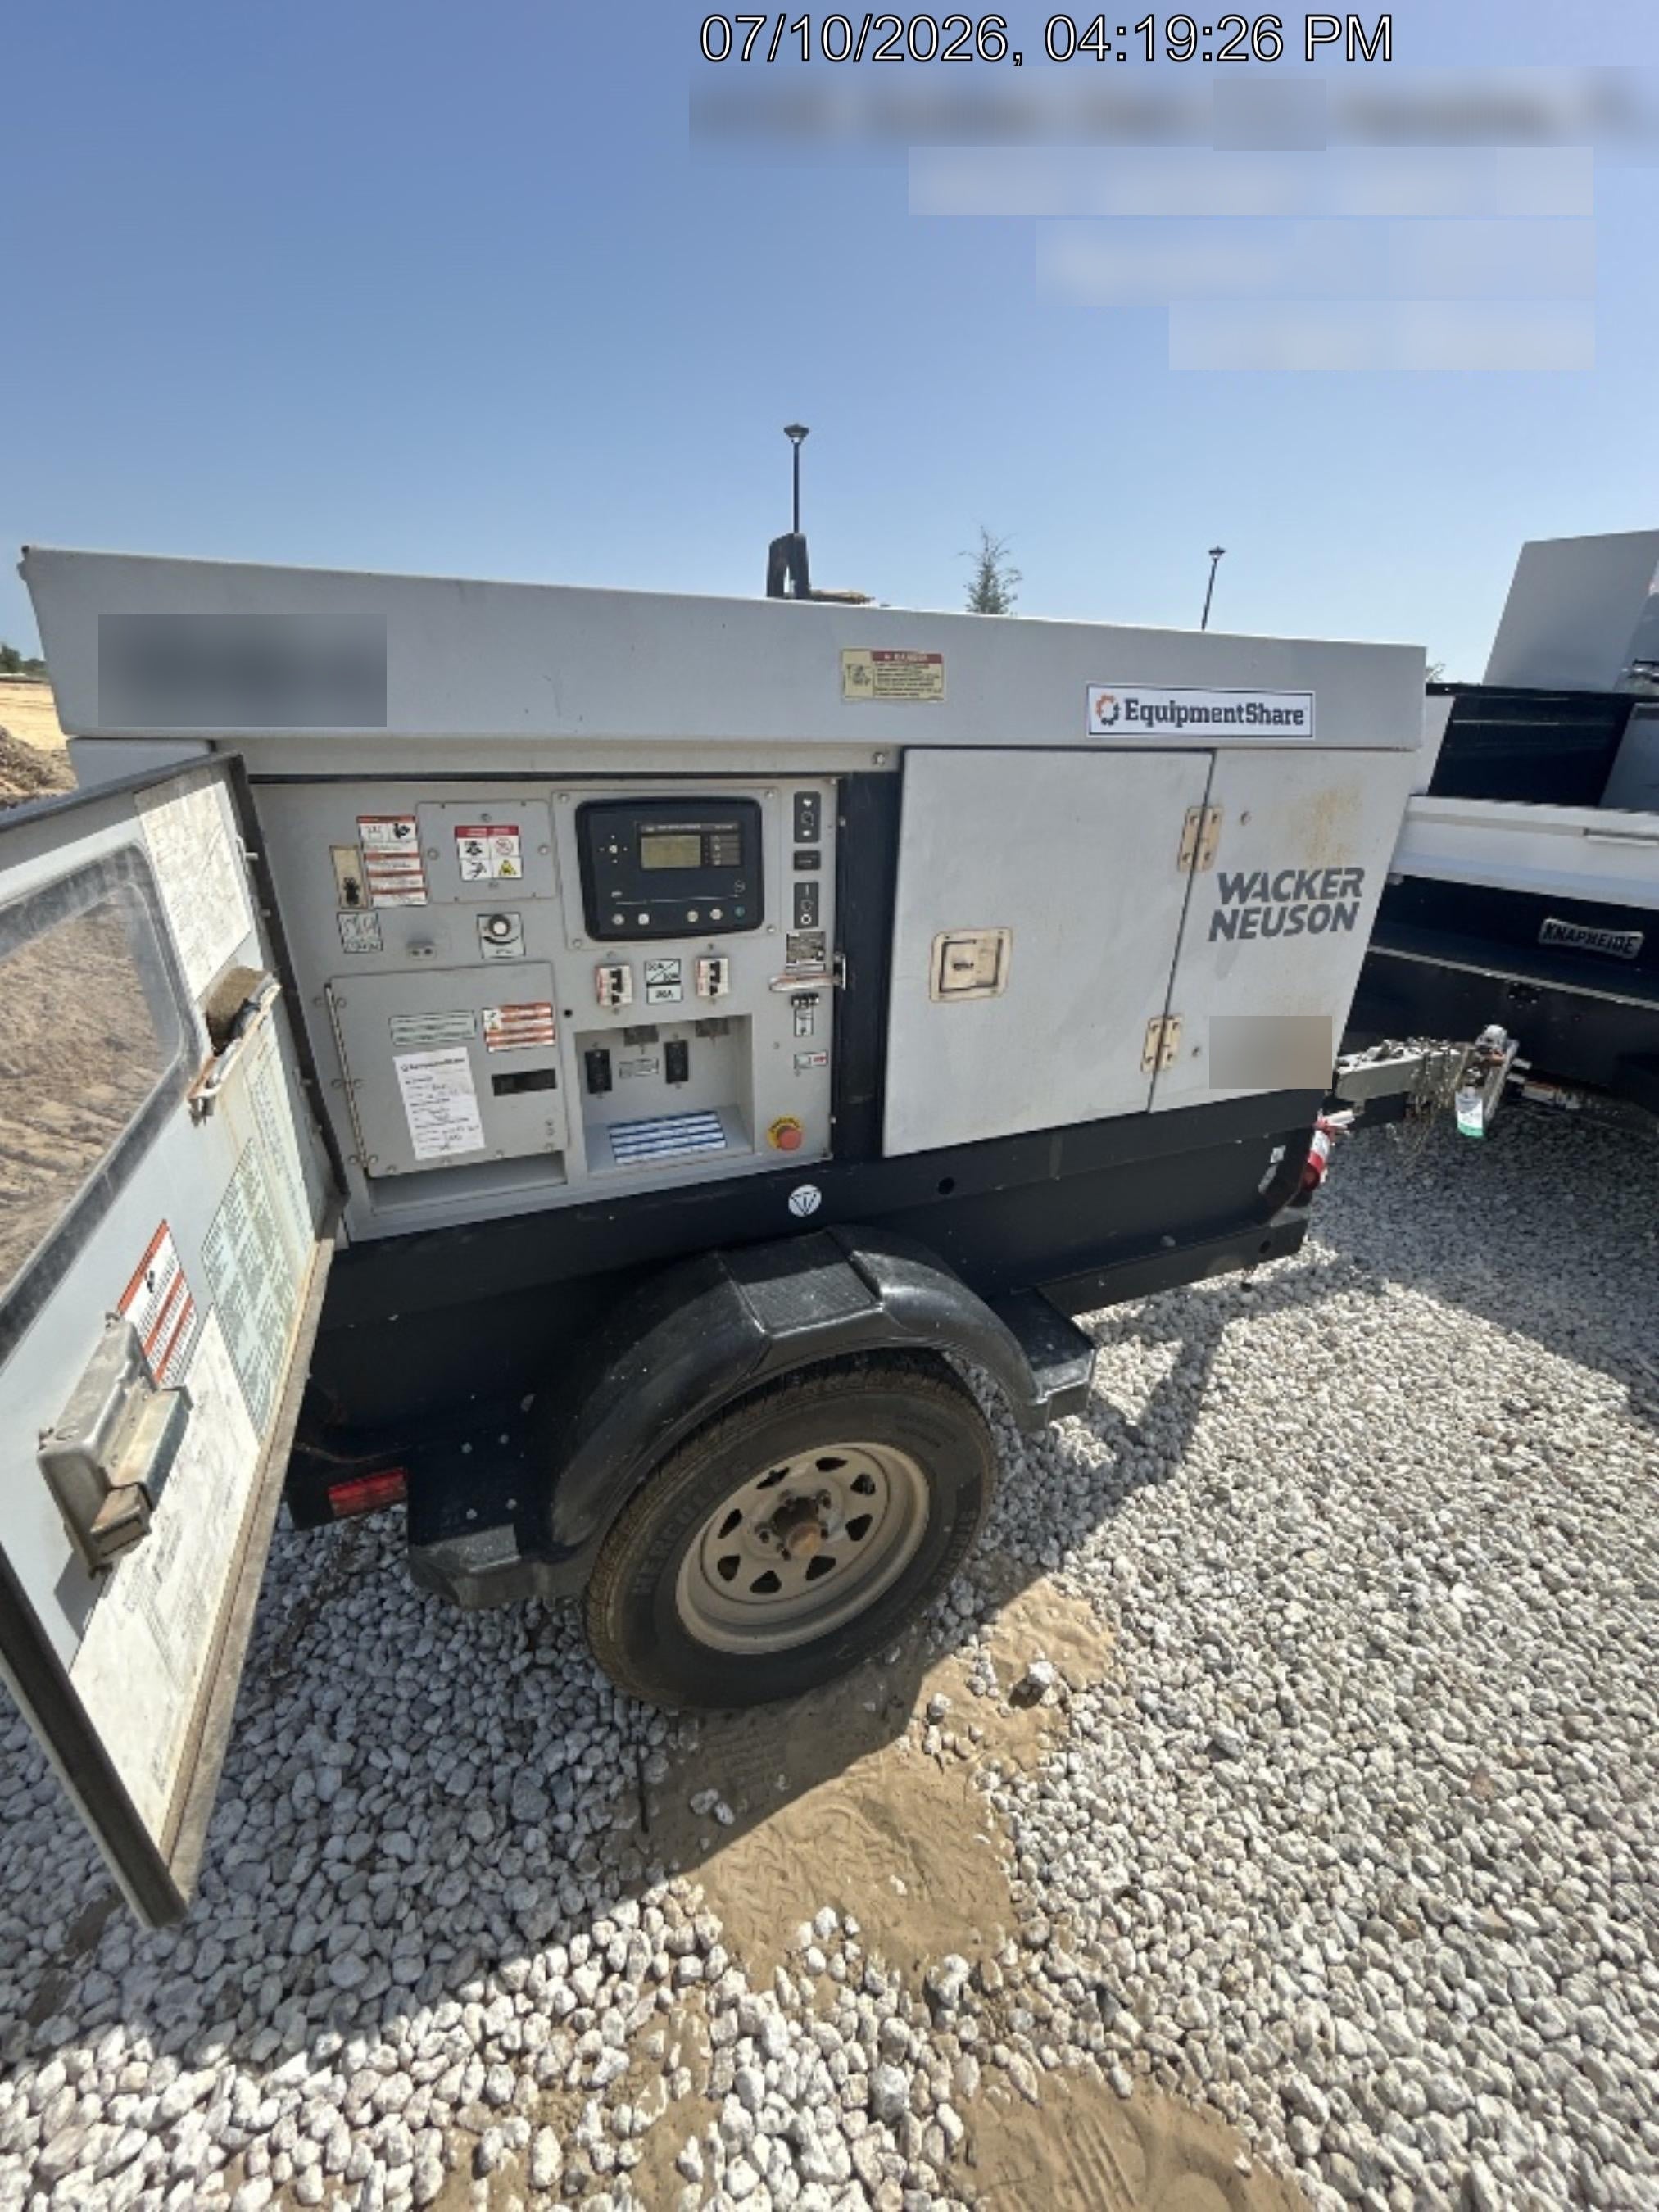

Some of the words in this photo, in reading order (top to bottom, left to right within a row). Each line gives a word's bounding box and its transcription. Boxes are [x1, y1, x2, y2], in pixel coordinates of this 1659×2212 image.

[1125, 698, 1304, 728] EquipmentShare
[1217, 867, 1365, 904] WACKER
[1208, 902, 1360, 941] NEUSON
[1543, 922, 1638, 954] KNAPHEIDE
